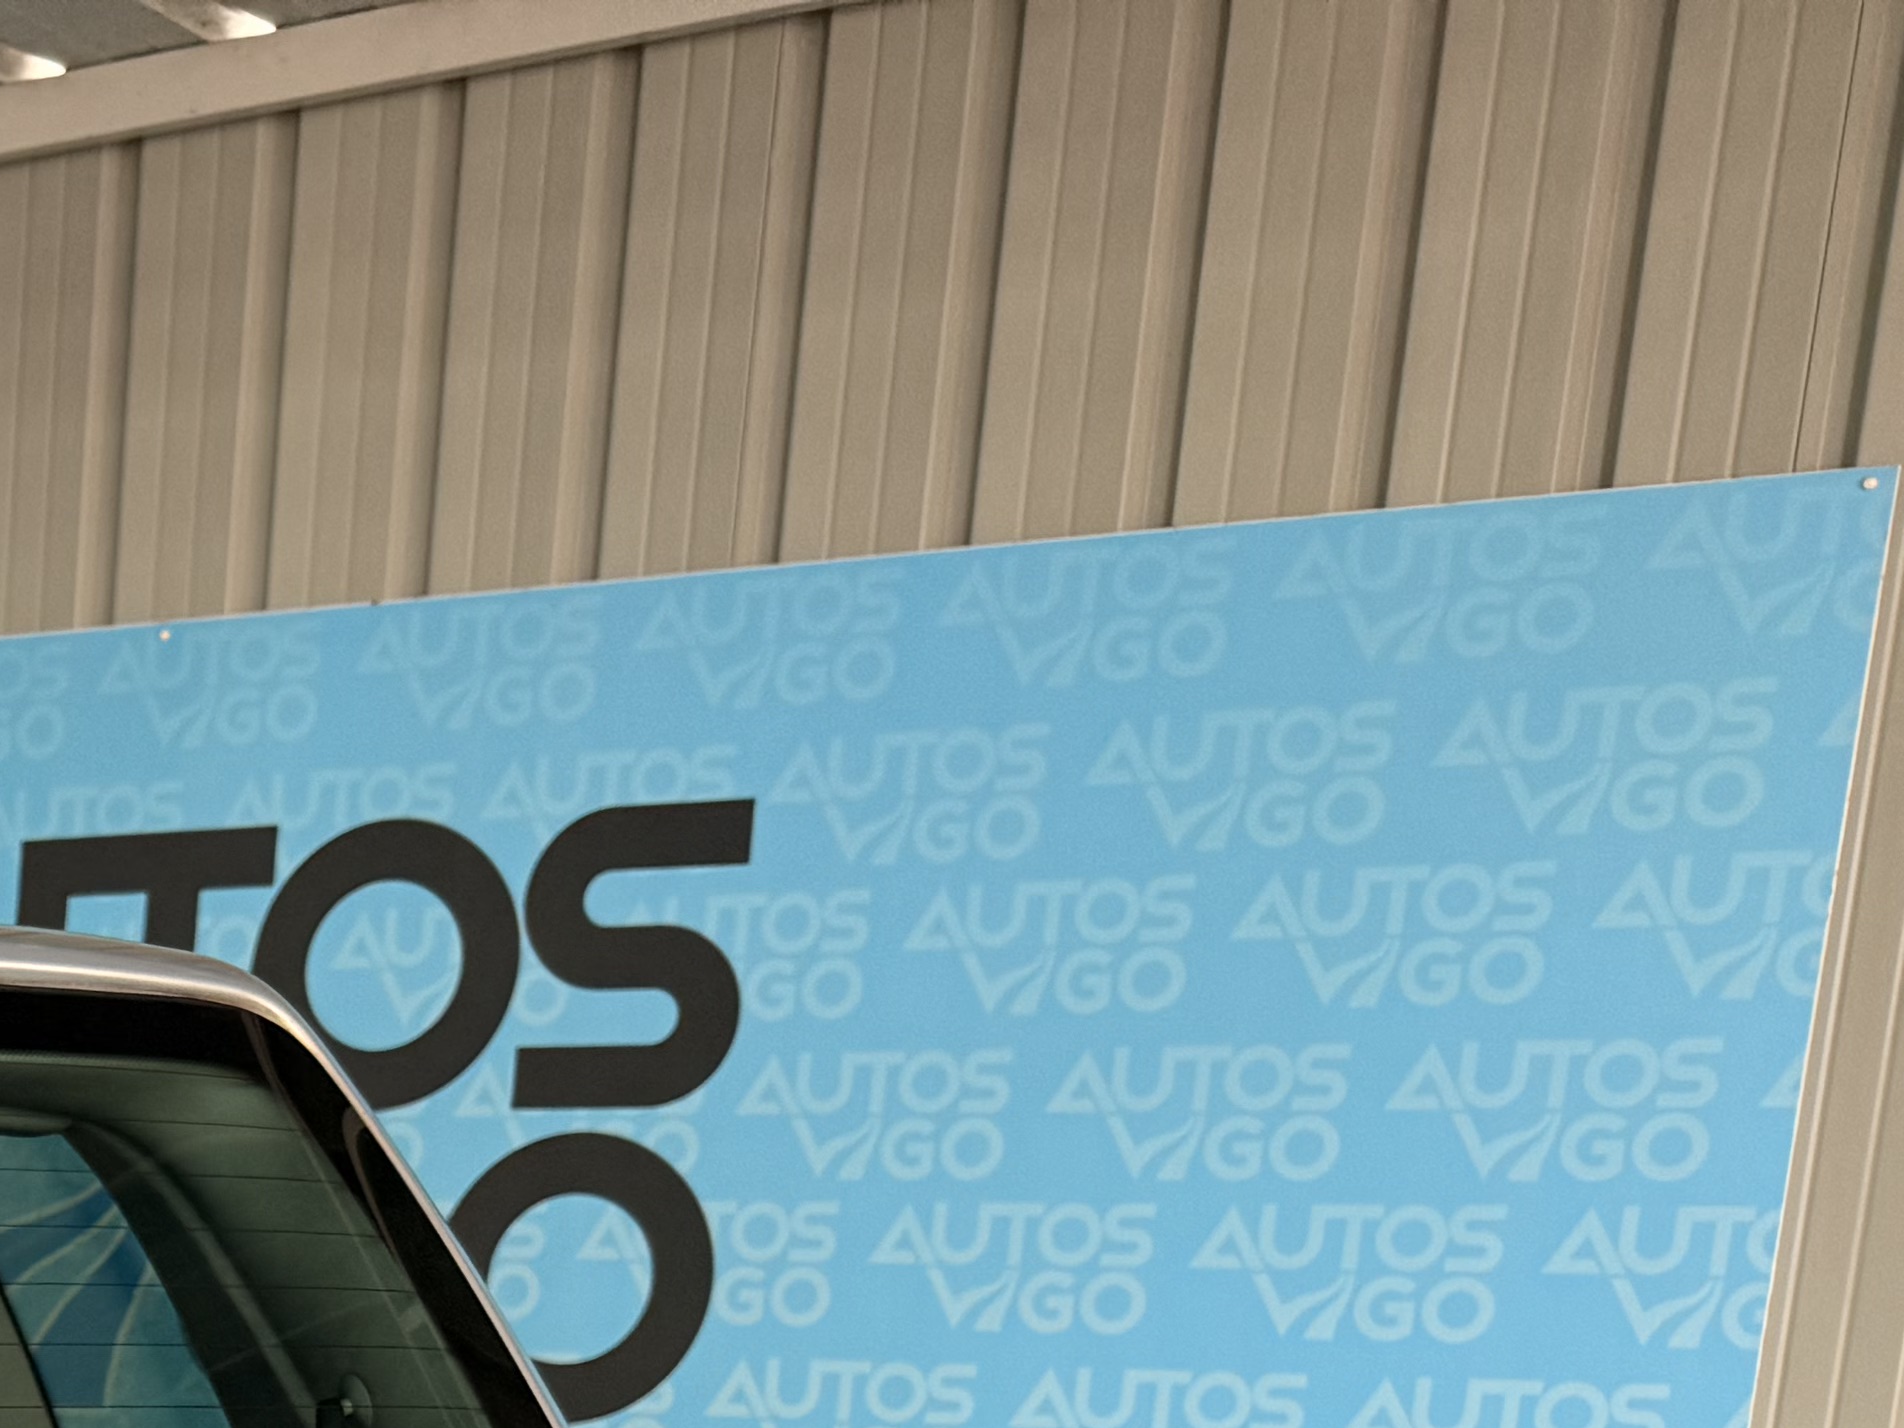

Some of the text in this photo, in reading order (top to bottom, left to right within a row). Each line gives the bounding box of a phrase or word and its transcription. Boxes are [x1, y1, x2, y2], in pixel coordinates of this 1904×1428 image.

[1338, 580, 1595, 664] VIGO
[1084, 698, 1397, 786] AUTOS
[1430, 674, 1780, 768] AUTOS
[1145, 773, 1386, 851] VIGO
[1499, 754, 1765, 837] VIGO
[901, 872, 1198, 952] AUTOS
[1229, 859, 1559, 942] AUTOS
[962, 946, 1188, 1017] VIGO
[1295, 933, 1546, 1010] VIGO
[733, 1046, 1016, 1118] AUTOS
[1044, 1040, 1354, 1115] AUTOS
[1383, 1033, 1725, 1113] AUTOS
[791, 1109, 1005, 1182] VIGO
[1106, 1106, 1342, 1183] VIGO
[1451, 1104, 1712, 1184] VIGO
[866, 1200, 1159, 1268] AUTOS
[1188, 1201, 1510, 1273] AUTOS
[927, 1261, 1148, 1334] VIGO
[1252, 1265, 1497, 1345] VIGO
[703, 1355, 978, 1427] AUTOS
